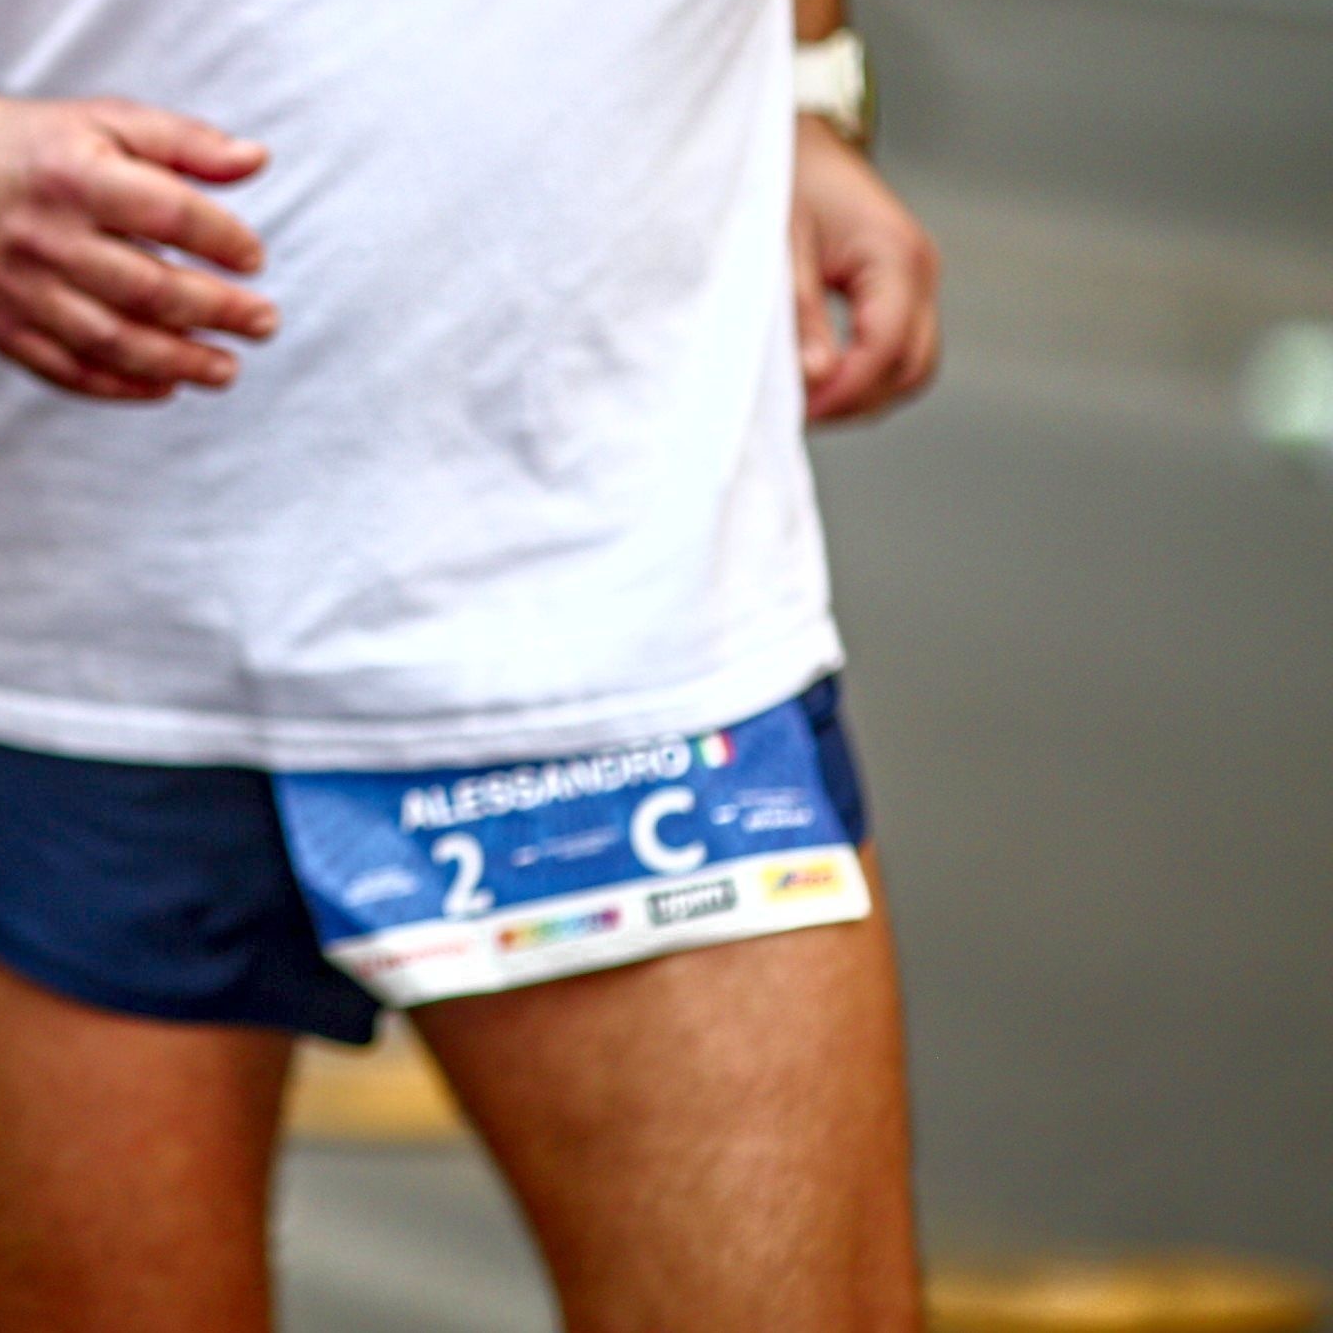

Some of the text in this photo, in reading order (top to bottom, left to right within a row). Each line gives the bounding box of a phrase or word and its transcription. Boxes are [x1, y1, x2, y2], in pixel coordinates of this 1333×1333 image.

[400, 742, 693, 834] ALESSANDRO
[630, 786, 707, 875] C
[434, 833, 494, 919] 2
